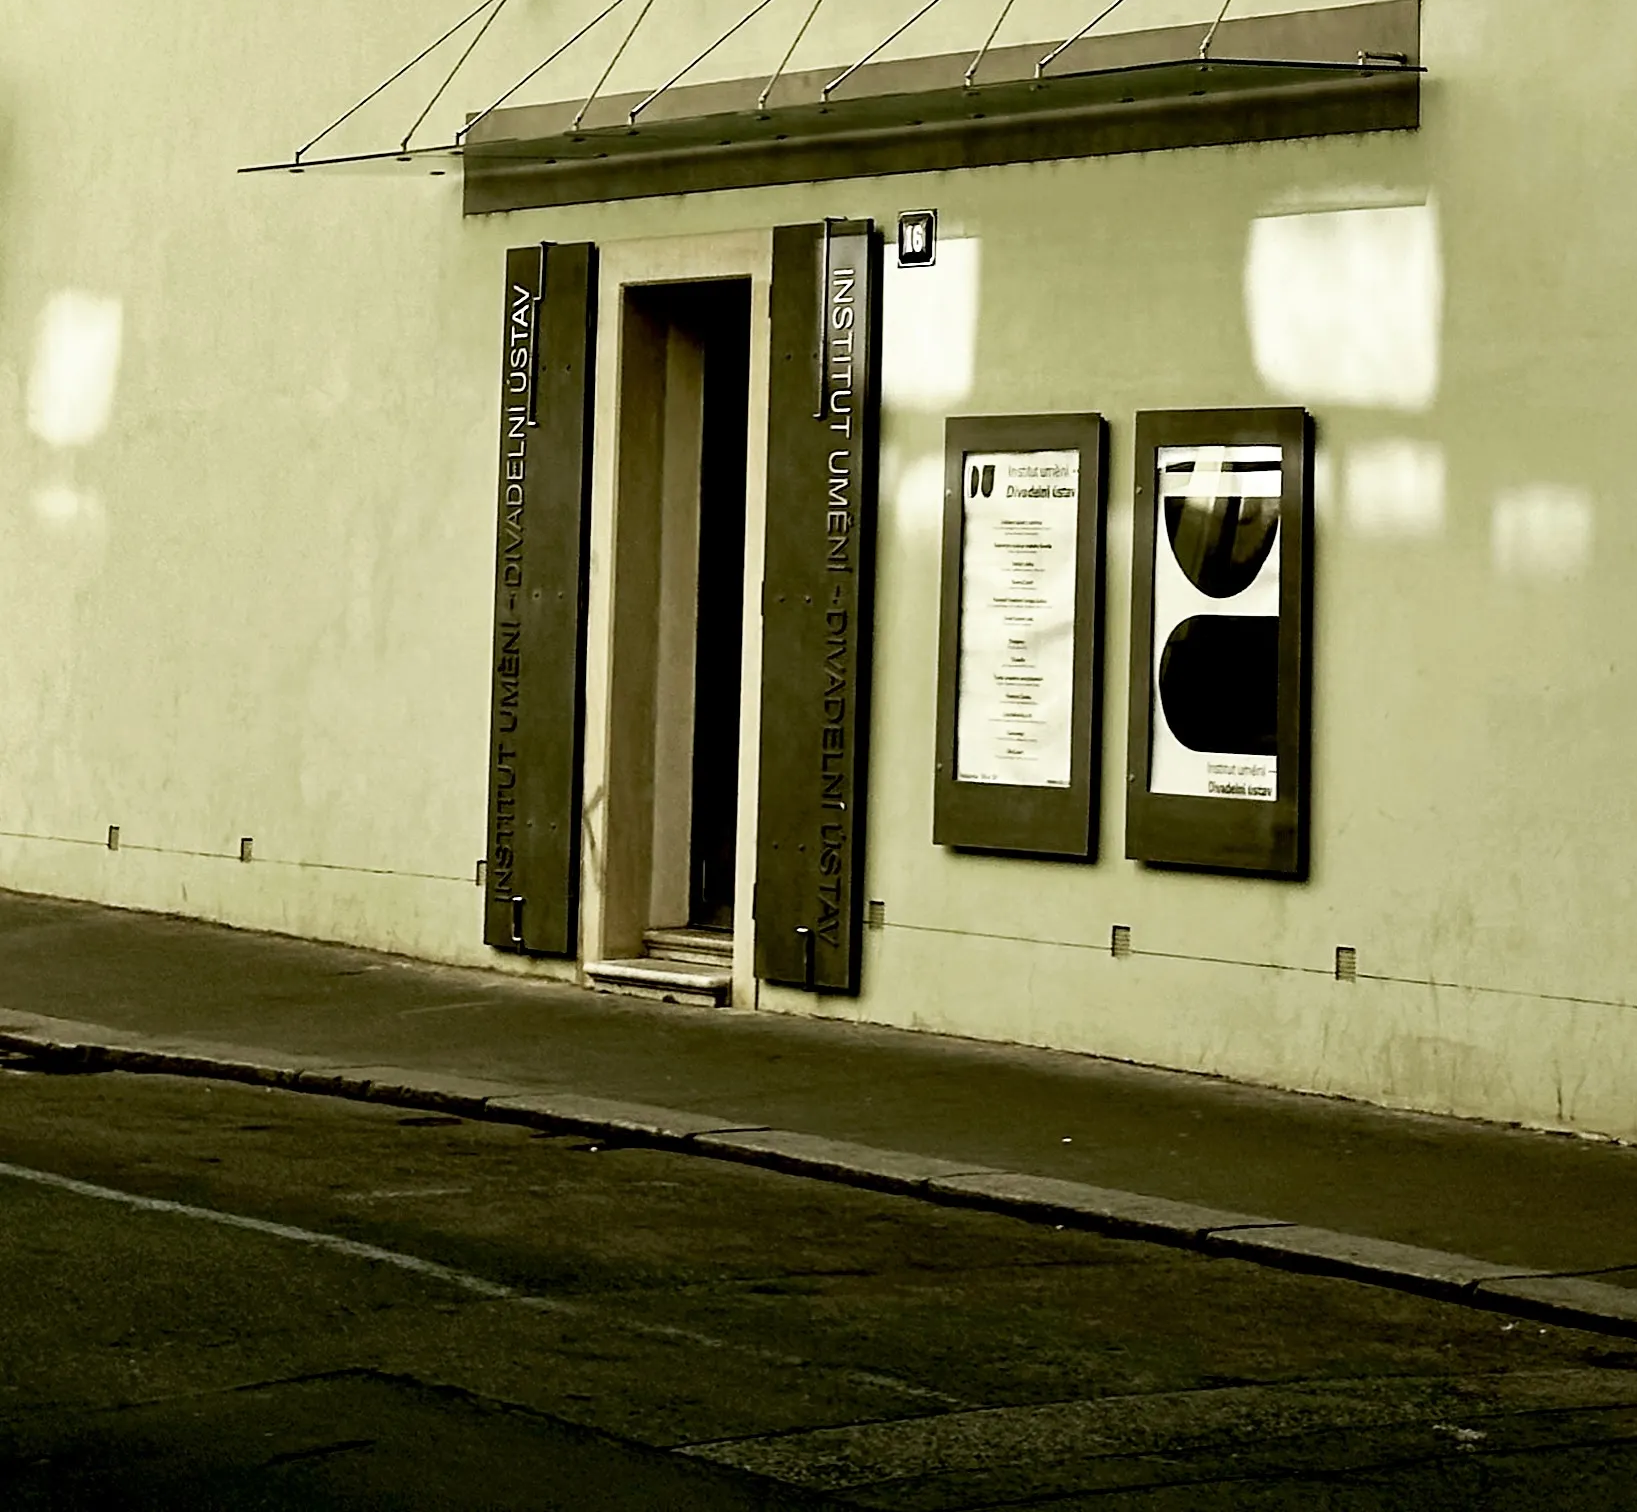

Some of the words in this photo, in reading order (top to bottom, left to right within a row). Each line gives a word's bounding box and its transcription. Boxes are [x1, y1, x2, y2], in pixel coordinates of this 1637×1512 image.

[904, 224, 924, 253] 16
[506, 284, 531, 393] ÚSTAV
[829, 268, 856, 439] INSTITUT
[504, 406, 527, 587] DIVADELNÍ
[826, 450, 855, 573] UMĚNÍ
[820, 609, 848, 812] DIVADELNÍ
[494, 744, 517, 903] INSTITUT
[816, 823, 847, 950] ÚSTAV
